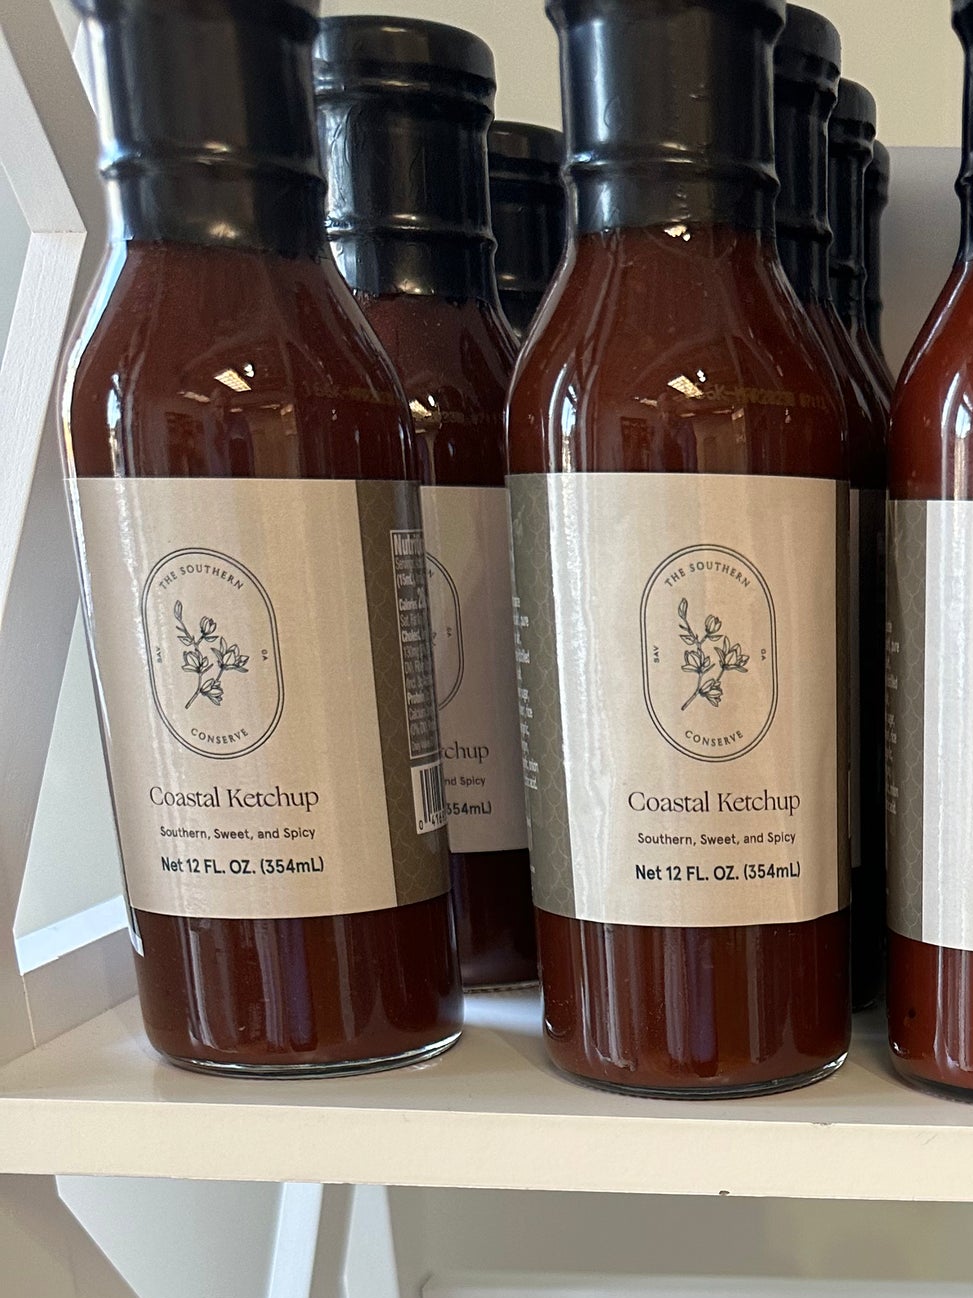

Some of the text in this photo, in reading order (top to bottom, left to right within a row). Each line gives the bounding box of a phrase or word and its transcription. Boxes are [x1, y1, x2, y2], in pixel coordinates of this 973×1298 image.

[159, 564, 243, 591] THE SOUTHERN
[664, 562, 750, 588] THE SOUTHERN
[191, 727, 249, 745] CONSERVE
[685, 729, 745, 748] CONSERVE
[443, 740, 490, 764] chup
[444, 776, 486, 788] nd Spicy
[150, 786, 320, 812] Coastal Ketchup
[446, 800, 492, 816] 354mL)
[628, 789, 801, 816] Coastal Ketchup
[160, 826, 316, 841] Southern, Sweet, and Spicy
[637, 831, 796, 846] Southern, Sweet, and Spicy
[162, 855, 324, 875] Net 12 FL. OZ. (354mL)
[635, 862, 801, 881] Net 12 FL. OZ. (354mL)
